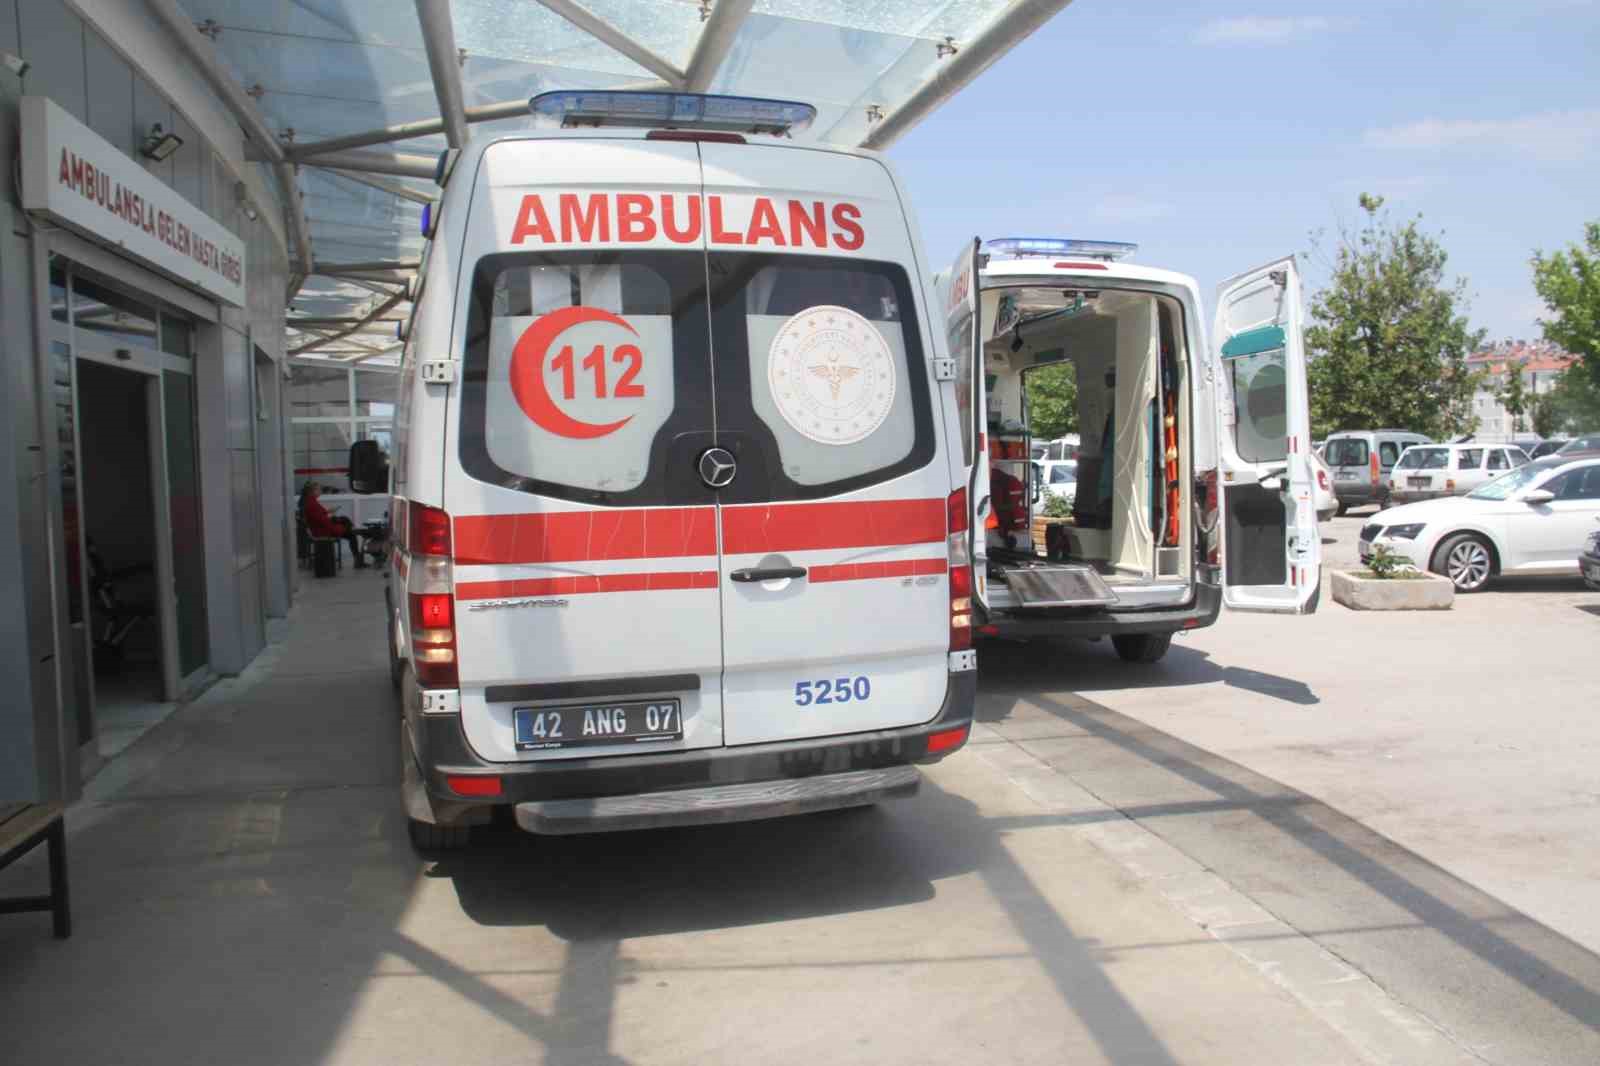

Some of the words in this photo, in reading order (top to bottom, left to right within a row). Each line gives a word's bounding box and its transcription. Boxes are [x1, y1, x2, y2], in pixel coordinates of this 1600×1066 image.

[59, 147, 155, 236] AMBULANSLA
[158, 209, 191, 257] GELEN
[510, 192, 865, 251] AMBULANS
[551, 344, 645, 400] 112
[795, 675, 871, 706] 5250
[532, 711, 563, 739] 42
[582, 707, 627, 737] ANG
[645, 704, 674, 731] 07
